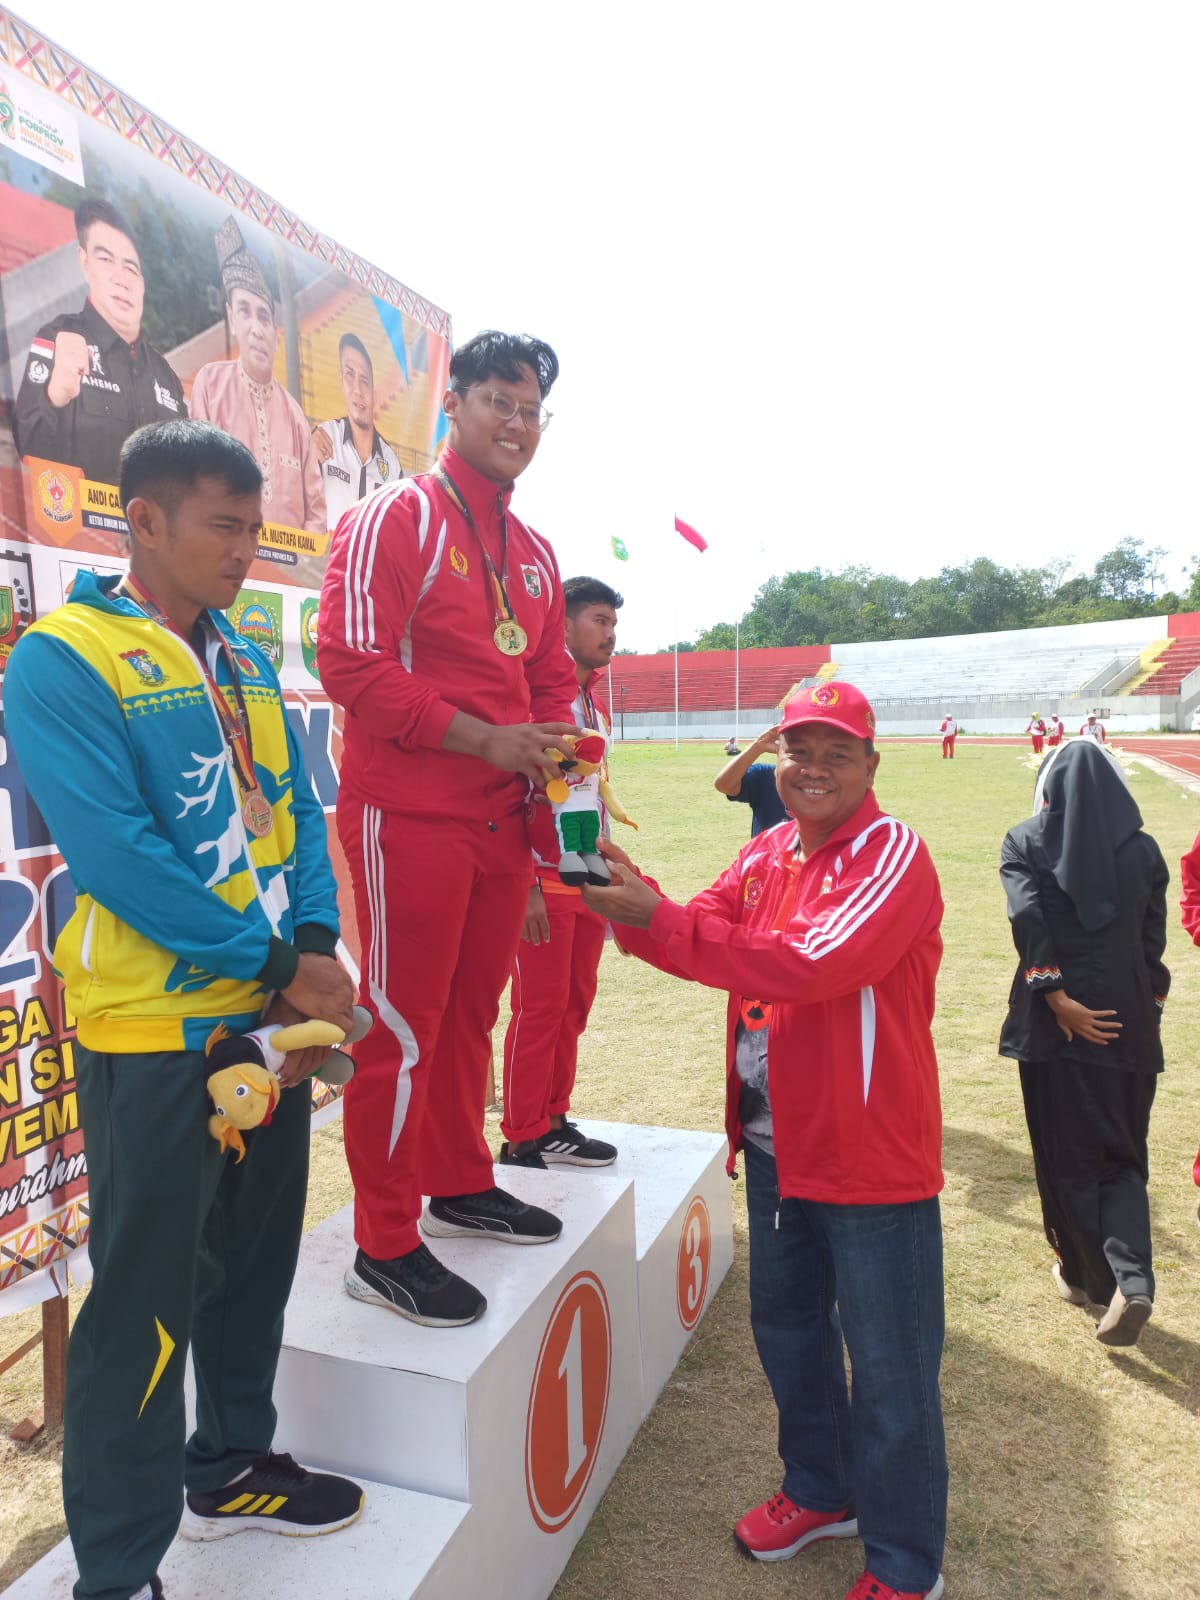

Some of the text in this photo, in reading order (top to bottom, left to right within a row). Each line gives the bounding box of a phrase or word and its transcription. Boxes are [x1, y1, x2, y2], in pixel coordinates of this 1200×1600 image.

[19, 115, 64, 146] PORPROV
[82, 375, 121, 393] AHENG
[88, 487, 122, 509] ANDI CA
[270, 528, 297, 548] MUSTAFA
[686, 1215, 703, 1311] 3
[557, 1304, 588, 1490] 1
